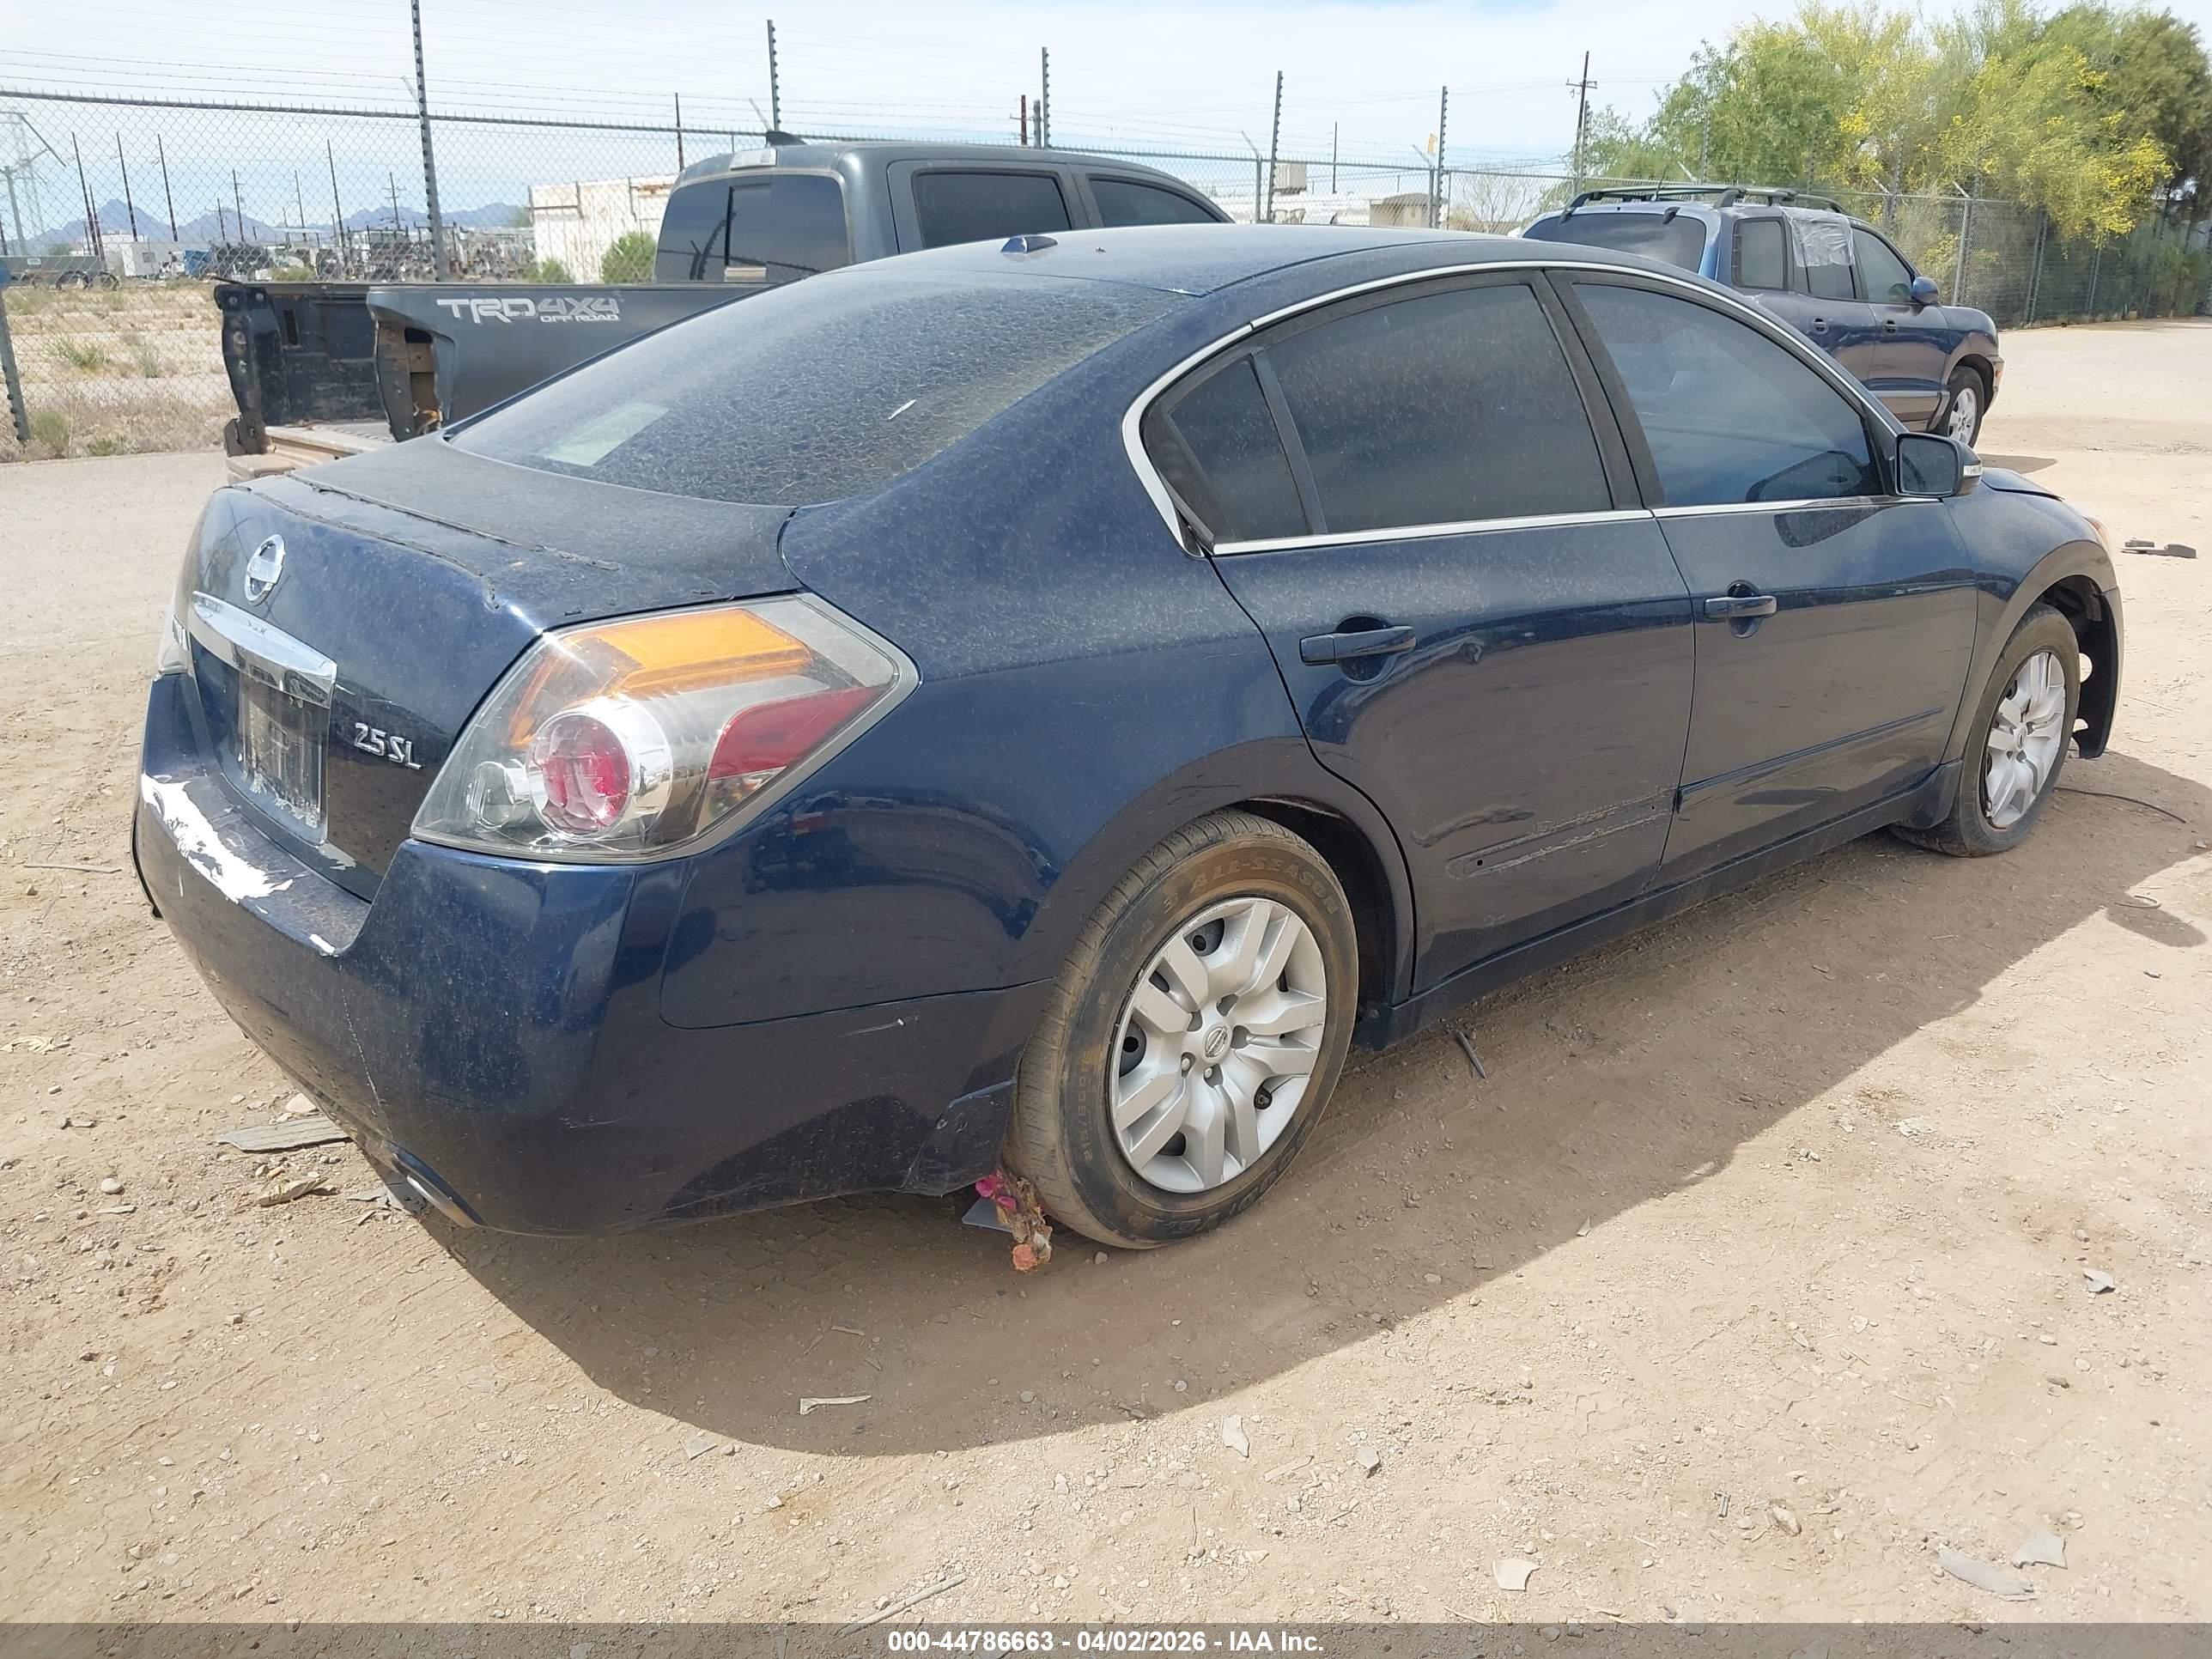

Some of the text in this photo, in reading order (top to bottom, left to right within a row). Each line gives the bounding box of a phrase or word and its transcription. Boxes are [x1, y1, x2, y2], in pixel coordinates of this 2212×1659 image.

[436, 298, 538, 325] TRD
[539, 314, 573, 323] OFF
[1190, 857, 1340, 915] ALL-SEASON
